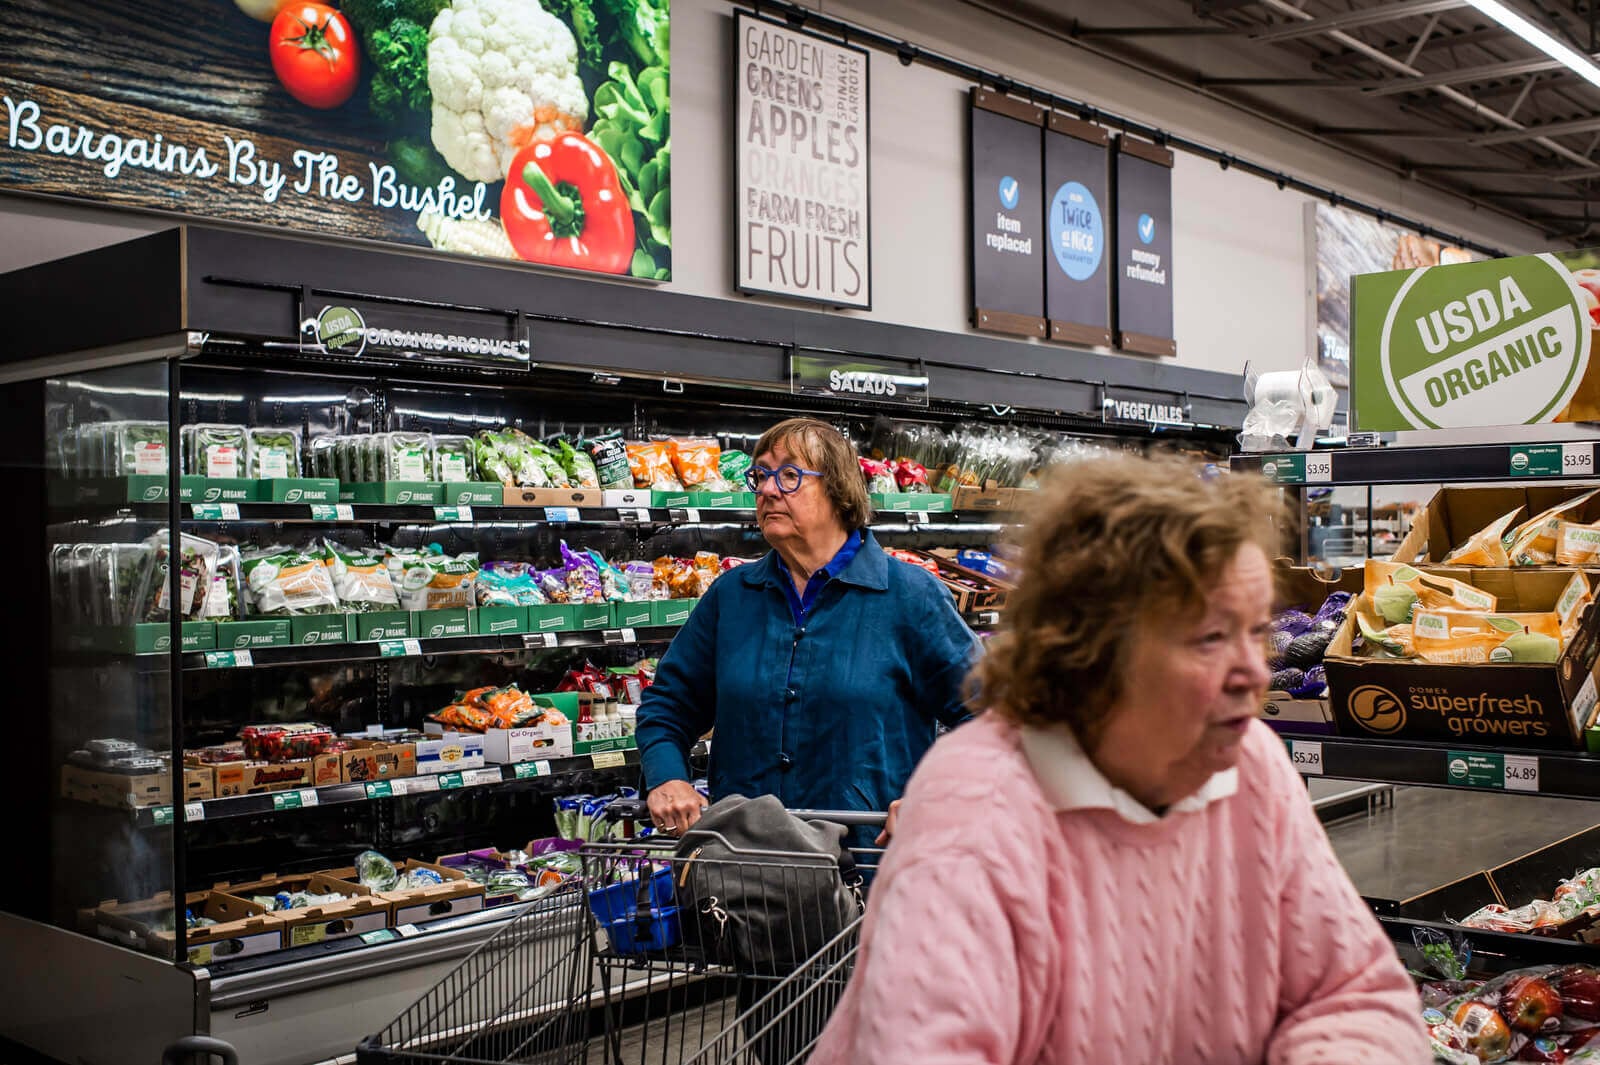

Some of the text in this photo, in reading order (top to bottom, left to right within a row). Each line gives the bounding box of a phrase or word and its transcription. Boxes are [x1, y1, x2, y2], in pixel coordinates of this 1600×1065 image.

[746, 26, 824, 79] GARDEN
[746, 62, 824, 114] GREENS
[747, 100, 860, 168] APPLES
[4, 97, 492, 221] Bargains By The Bushel
[747, 187, 860, 239] FARM FRESH
[997, 212, 1021, 234] item
[1061, 201, 1092, 230] Twice
[986, 233, 1032, 255] replaced
[748, 221, 861, 297] FRUITS
[1131, 249, 1161, 268] money
[1127, 265, 1166, 284] refunded
[325, 314, 353, 334] USDA
[1415, 276, 1532, 355] USDA
[366, 328, 519, 356] ORGANIC PRODUCE
[1424, 326, 1562, 408] ORGANIC
[830, 369, 897, 397] SALADS
[1115, 400, 1183, 423] VEGETABLES
[1307, 464, 1330, 474] $3.95
[1564, 455, 1591, 466] $3.95
[223, 490, 247, 499] ORGANIC
[304, 490, 327, 500] ORGANIC
[321, 631, 342, 640] ORGANIC
[1409, 687, 1448, 695] DOMEX
[1411, 692, 1544, 717] superfresh
[510, 730, 521, 738] Cal
[1448, 717, 1548, 737] growers
[1294, 752, 1320, 764] $5.29
[1505, 766, 1537, 780] $4.89
